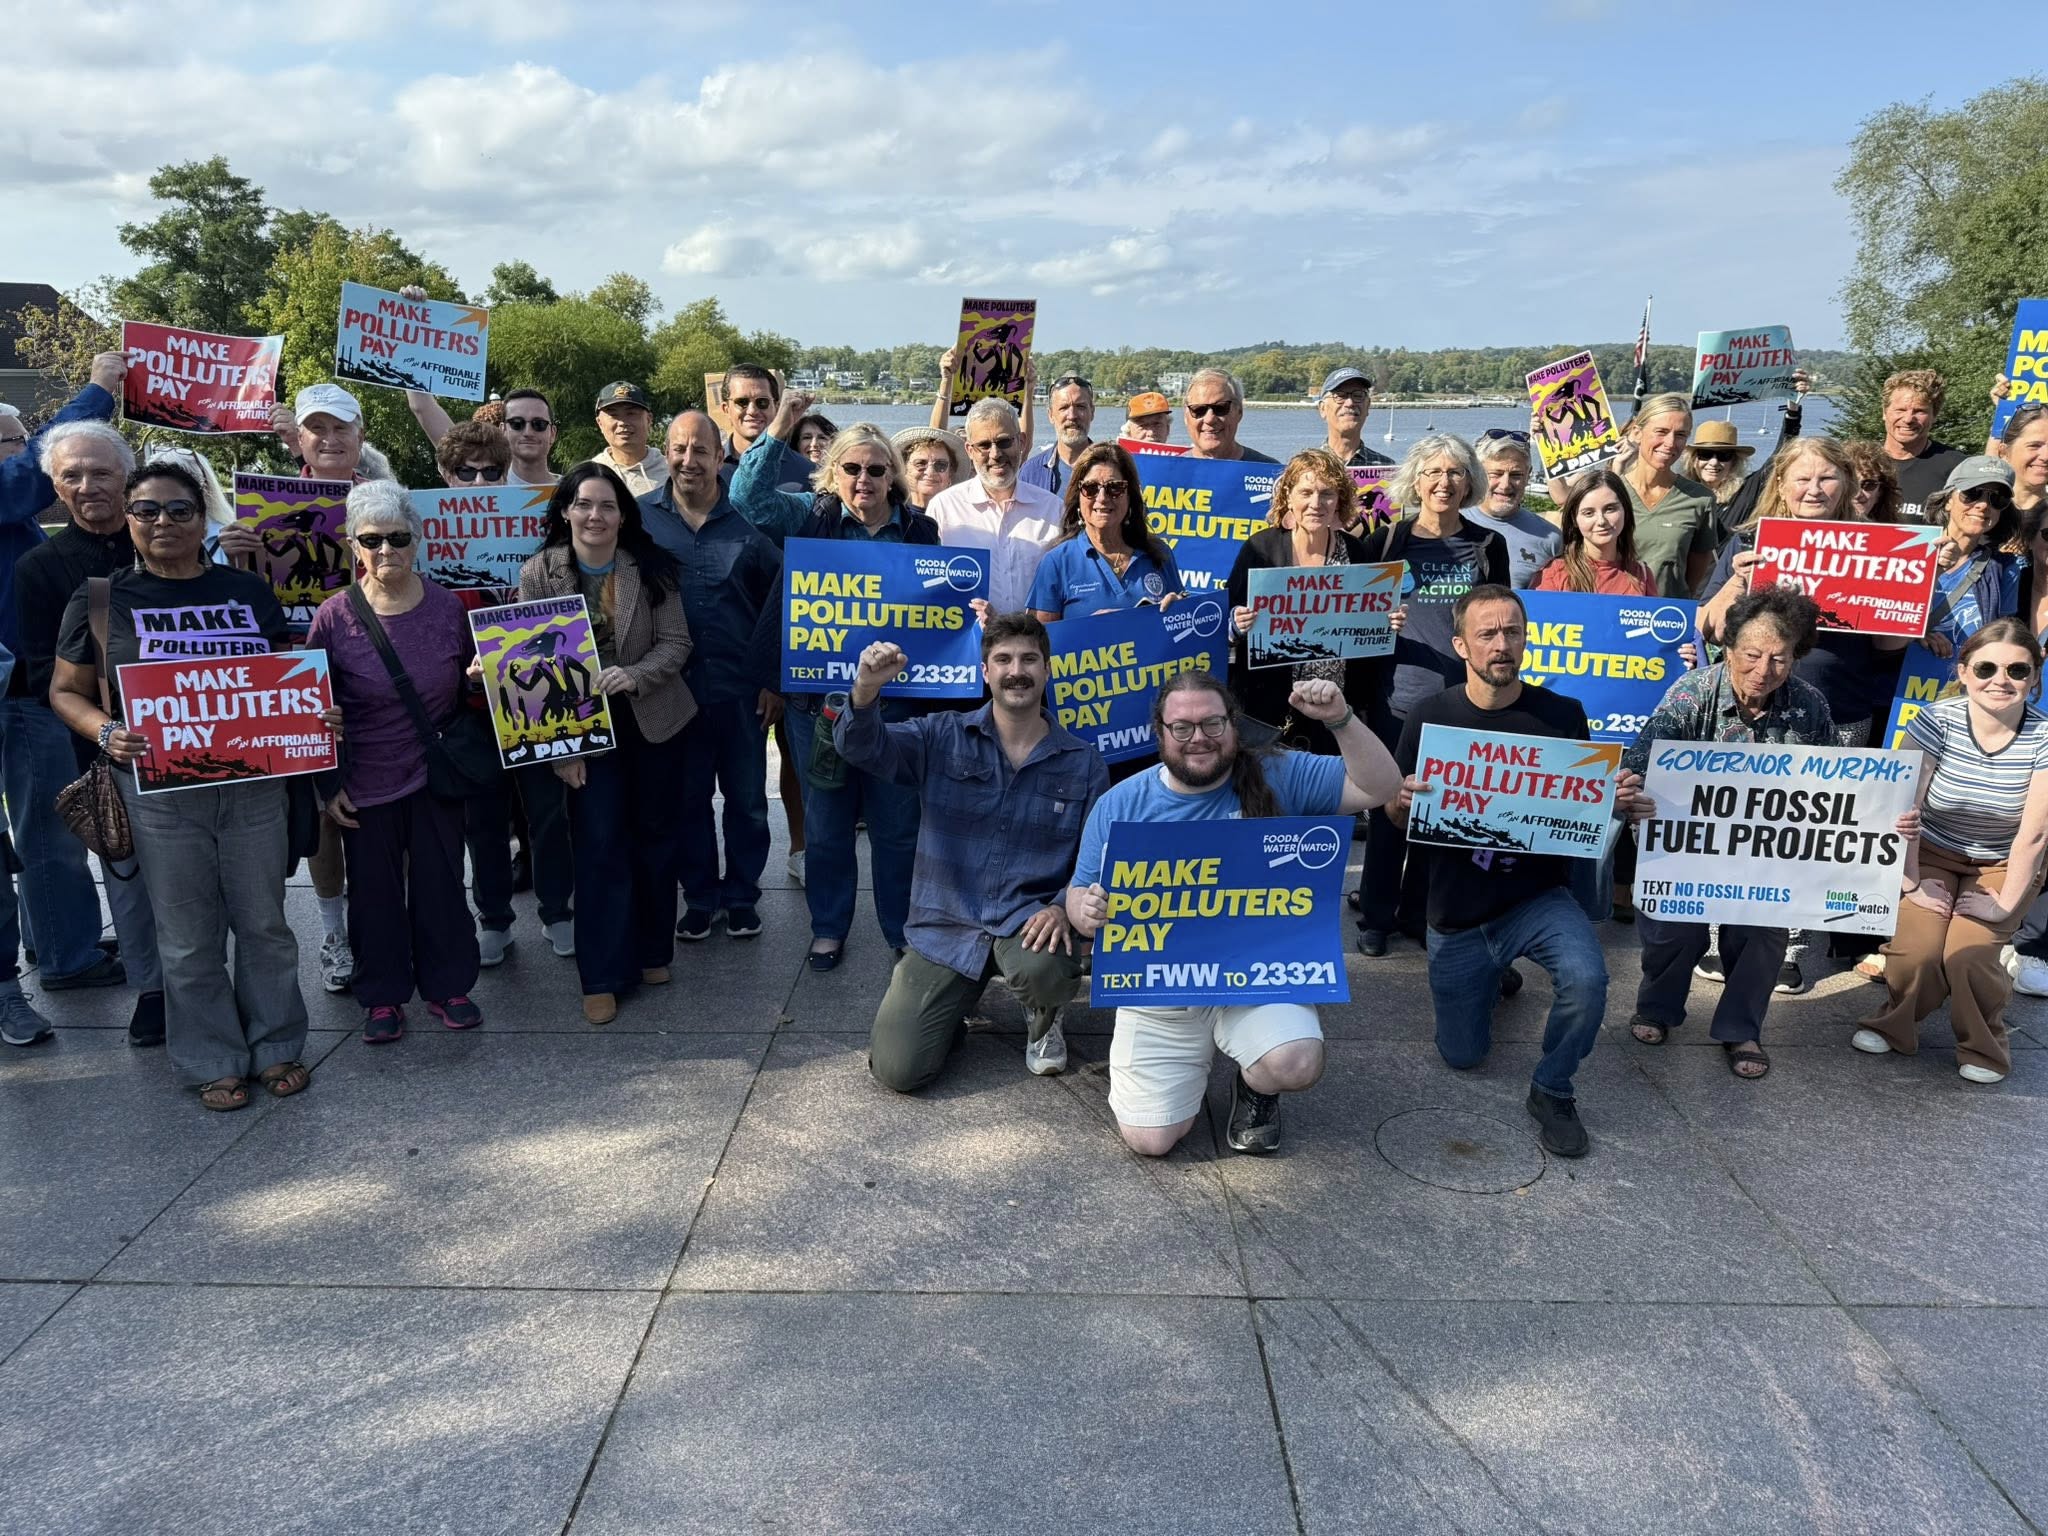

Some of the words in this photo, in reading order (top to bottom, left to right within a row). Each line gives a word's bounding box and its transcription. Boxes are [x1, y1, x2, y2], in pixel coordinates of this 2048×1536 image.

[378, 298, 432, 324] MAKE
[964, 300, 989, 311] MAKE
[991, 301, 1035, 313] POLLUTERS
[344, 308, 479, 356] POLLUTERS
[1728, 333, 1771, 352] MAKE
[167, 336, 230, 361] MAKE
[360, 335, 399, 359] PAY
[127, 346, 271, 387] POLLUTERS
[1528, 370, 1545, 383] MAKE
[1546, 353, 1591, 377] POLLUTERS
[1700, 348, 1794, 371] POLLUTER
[420, 361, 482, 382] AFFORDABLE
[443, 375, 480, 391] FUTURE
[1711, 370, 1743, 386] PAY
[147, 374, 192, 400] PAY
[2007, 379, 2048, 404] PA
[217, 400, 272, 411] AFFORDABLE
[236, 409, 271, 420] FUTURE
[1566, 449, 1600, 471] PAY
[237, 476, 275, 493] MAKE
[277, 478, 350, 497] POLLUTERS
[1244, 475, 1274, 485] FOOD&
[1244, 484, 1273, 493] WATER
[438, 496, 499, 515] MAKE
[427, 541, 468, 561] PAY
[1800, 529, 1870, 552] MAKE
[914, 558, 946, 568] FOOD&
[915, 567, 946, 577] WATER
[947, 568, 979, 579] WATCH
[1422, 562, 1471, 573] CLEAN
[1757, 546, 1928, 585] POLLUTERS
[790, 570, 882, 599] MAKE
[1287, 574, 1344, 592] MAKE
[1420, 573, 1472, 583] WATER
[1418, 584, 1473, 596] ACTION
[473, 608, 514, 626] MAKE
[515, 599, 583, 619] POLLUTERS
[790, 598, 964, 630] POLLUTERS
[1253, 591, 1393, 615] POLLUTERS
[1619, 609, 1652, 618] FOOD&
[1847, 595, 1926, 614] AFFORDABLE
[141, 608, 252, 633] MAKE
[1163, 611, 1192, 625] FOOD&
[1165, 620, 1192, 632] WATER
[1193, 613, 1220, 625] WATCH
[1269, 616, 1309, 636] PAY
[1619, 617, 1650, 627] WATER
[1652, 620, 1684, 629] WATCH
[1873, 609, 1923, 624] FUTURE
[789, 626, 849, 652] PAY
[1331, 626, 1393, 637] AFFORDABLE
[1353, 635, 1392, 646] FUTURE
[1526, 621, 1584, 648] AKE
[147, 638, 267, 656] POLLUTERS
[1050, 641, 1138, 680] MAKE
[174, 666, 253, 694] MAKE
[789, 666, 825, 680] TEXT
[826, 661, 860, 681] FW
[911, 664, 976, 684] 23321
[131, 687, 324, 727] POLLUTERS
[1057, 700, 1113, 730] PAY
[162, 724, 216, 751] PAY
[226, 736, 243, 748] FOR
[238, 739, 249, 750] AN
[251, 732, 332, 748] AFFORDABLE
[533, 736, 584, 759] PAY
[1097, 723, 1151, 752] FWW
[284, 744, 332, 759] FUTURE
[1468, 741, 1544, 768] MAKE
[1656, 748, 1794, 777] GOVERNOR
[1800, 754, 1914, 783] MURPHY:
[1421, 757, 1606, 804] POLLUTERS
[1440, 789, 1494, 815] PAY
[1690, 783, 1739, 819] NO
[1744, 786, 1860, 827] FOSSIL
[1498, 811, 1514, 819] FOR
[1507, 815, 1520, 823] AN
[1520, 814, 1604, 834] AFFORDABLE
[1263, 834, 1300, 844] FOOD&
[1263, 843, 1297, 853] WATER
[1300, 842, 1337, 853] WATCH
[1549, 829, 1600, 846] FUTURE
[1645, 818, 1720, 856] FUEL
[1727, 823, 1900, 867] PROJECTS
[1110, 857, 1222, 889] MAKE
[1642, 879, 1673, 897] TEXT
[1674, 881, 1693, 898] NO
[1697, 883, 1746, 901] FOSSIL
[1747, 885, 1791, 904] FUELS
[1825, 889, 1859, 902] food&
[1105, 887, 1314, 920] POLLUTERS
[1640, 898, 1657, 913] TO
[1659, 899, 1706, 916] 69866
[1824, 899, 1858, 912] water
[1858, 901, 1890, 916] watch
[1102, 922, 1174, 953] PAY
[1101, 973, 1143, 988] TEXT
[1146, 963, 1220, 988] FWW
[1223, 971, 1248, 987] TO
[1250, 961, 1337, 986] 23321
